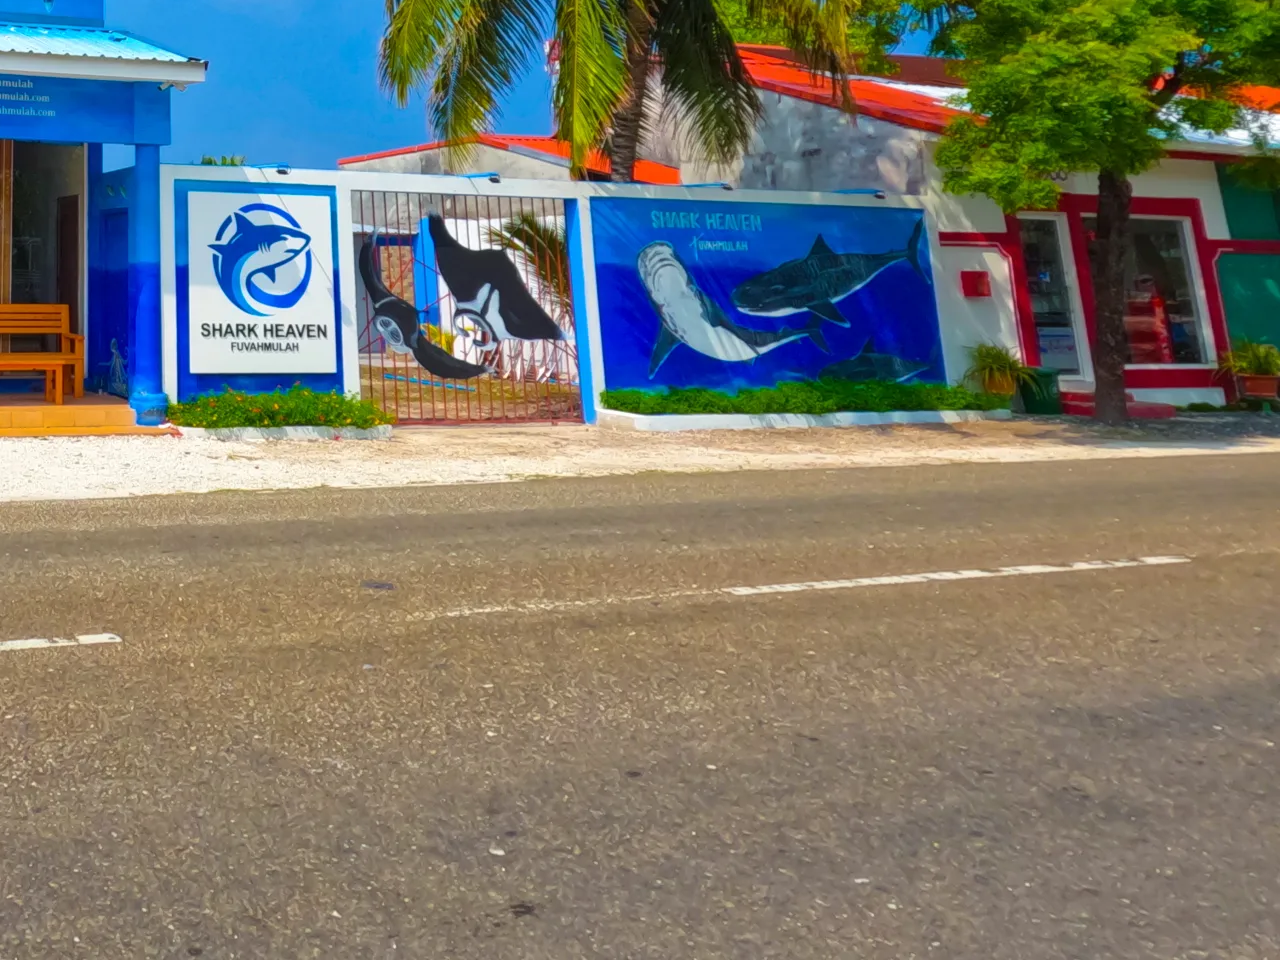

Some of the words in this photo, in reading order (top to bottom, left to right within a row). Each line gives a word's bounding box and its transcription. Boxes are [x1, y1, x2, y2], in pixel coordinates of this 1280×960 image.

[651, 210, 700, 229] SHARK
[705, 213, 762, 232] HEAVEN
[201, 323, 258, 338] SHARK
[263, 324, 328, 339] HEAVEN
[230, 342, 300, 353] FUVAHMULAH
